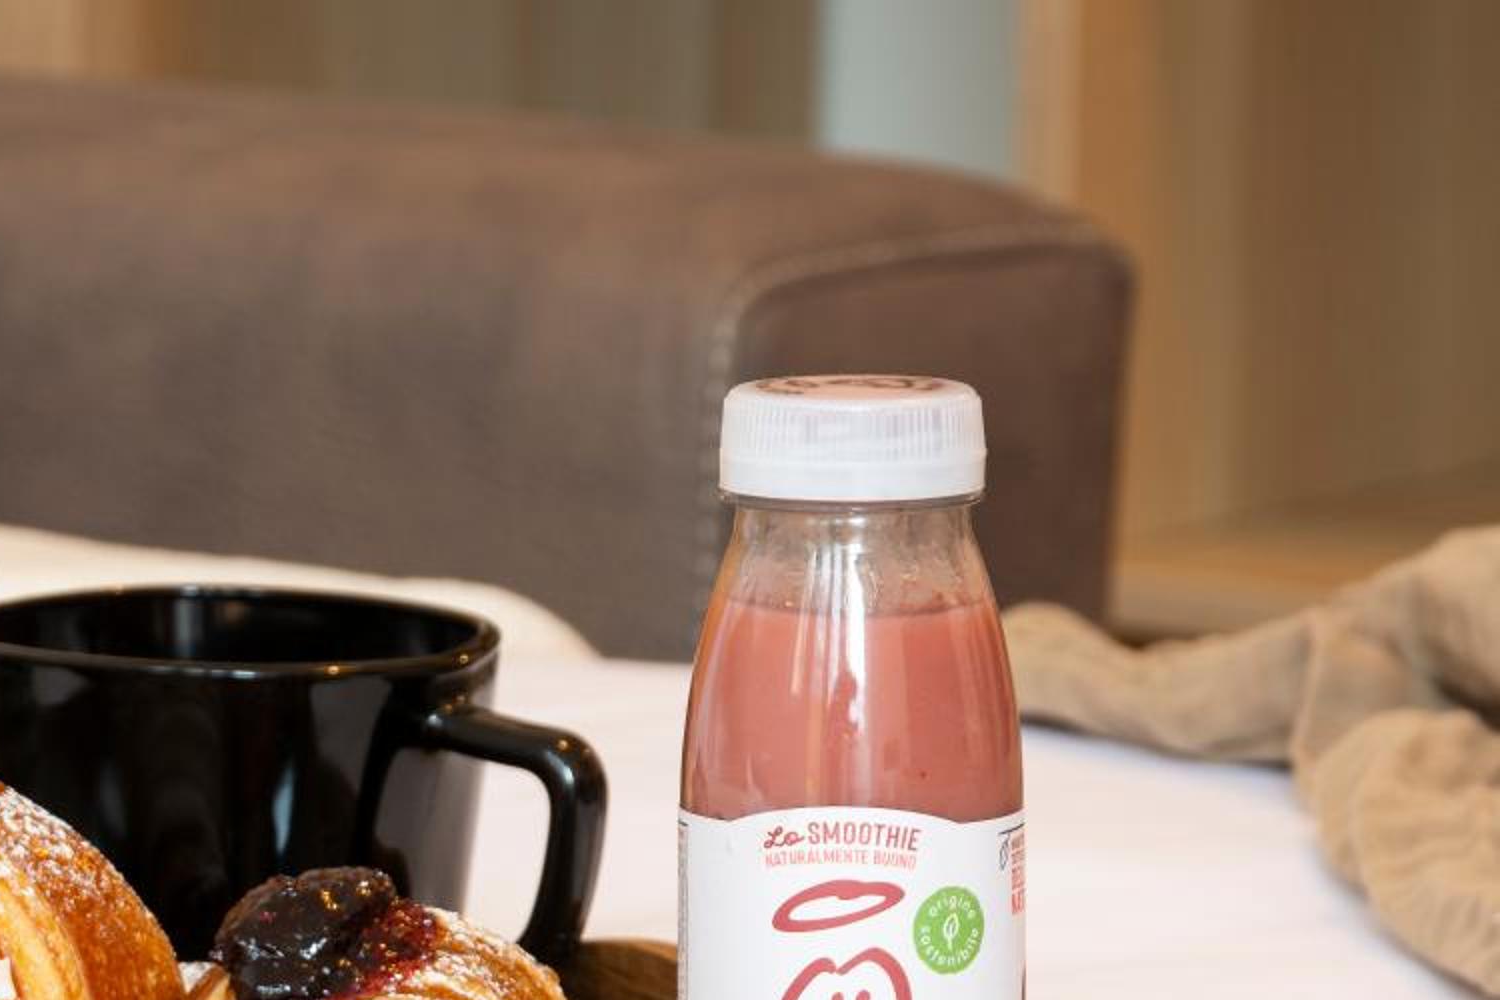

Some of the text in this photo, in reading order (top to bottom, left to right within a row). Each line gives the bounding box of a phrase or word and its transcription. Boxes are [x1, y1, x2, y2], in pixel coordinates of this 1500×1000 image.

[807, 821, 922, 851] SMOOTHIE
[765, 849, 917, 871] NATURALMENTE BUONO
[928, 893, 977, 919] origine
